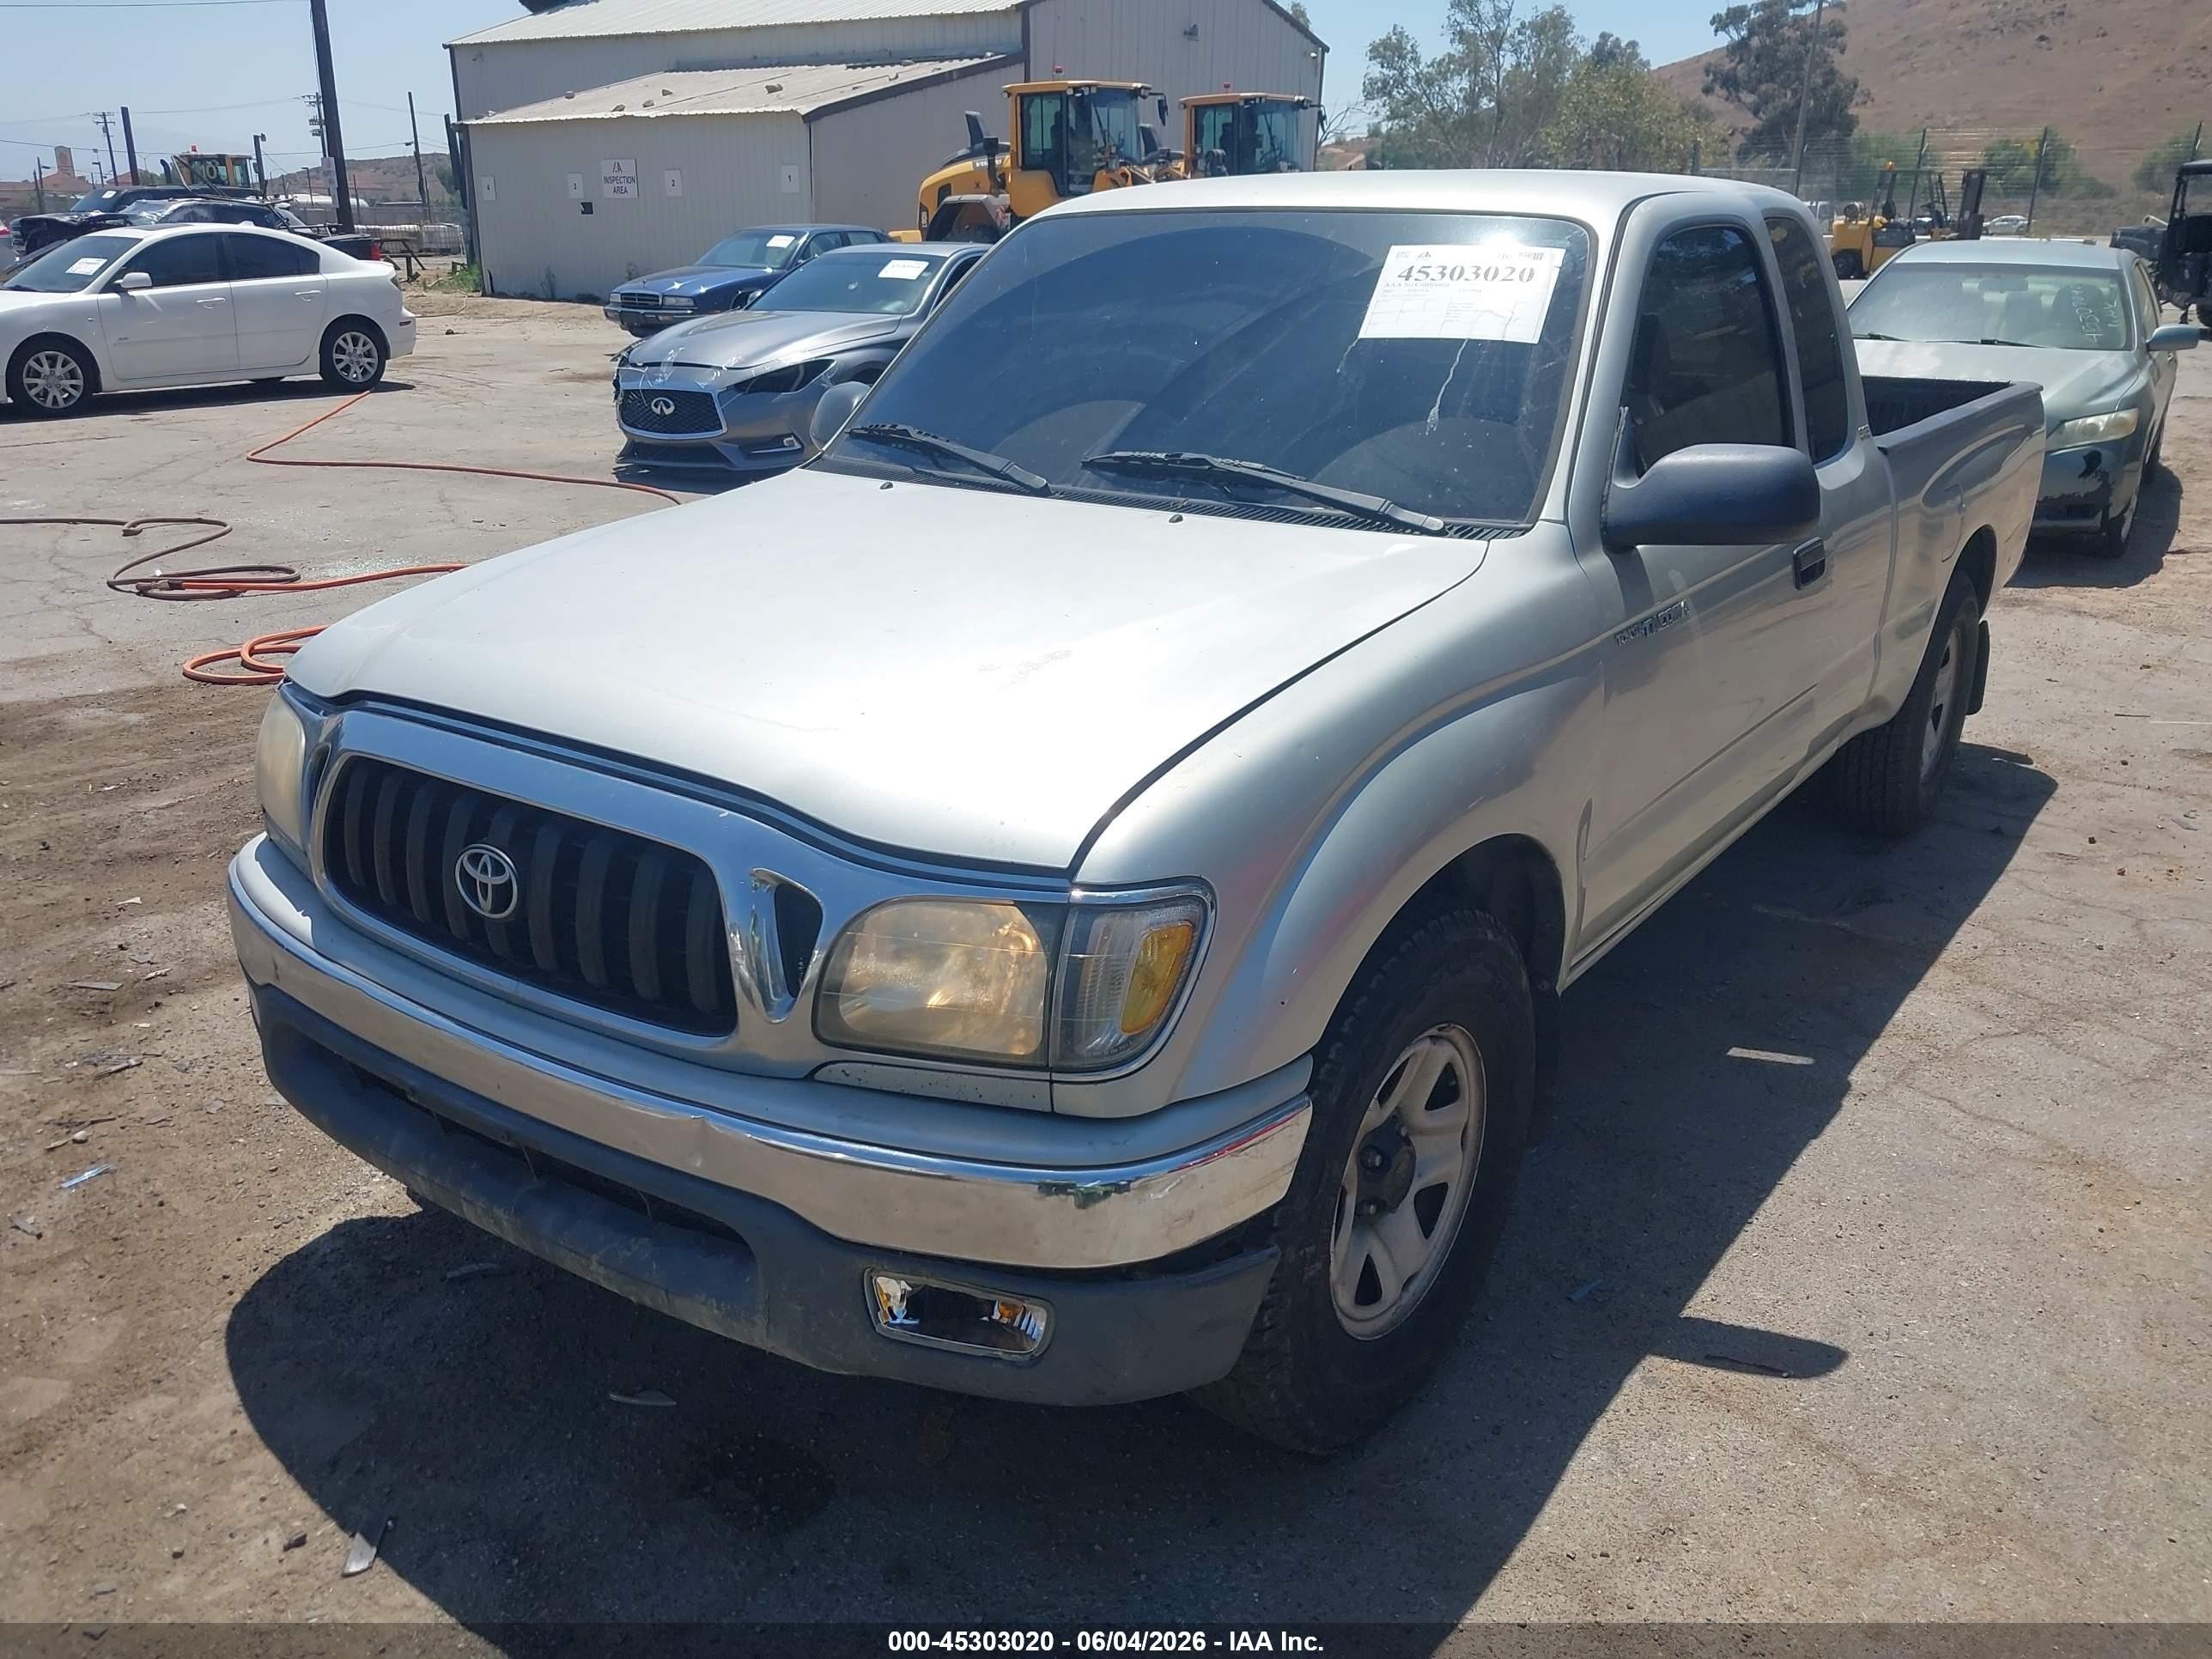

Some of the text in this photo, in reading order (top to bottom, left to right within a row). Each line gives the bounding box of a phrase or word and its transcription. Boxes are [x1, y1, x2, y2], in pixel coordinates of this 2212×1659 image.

[603, 175, 635, 184] INSPECTION
[613, 185, 628, 194] AREA
[1397, 264, 1535, 283] 45303020
